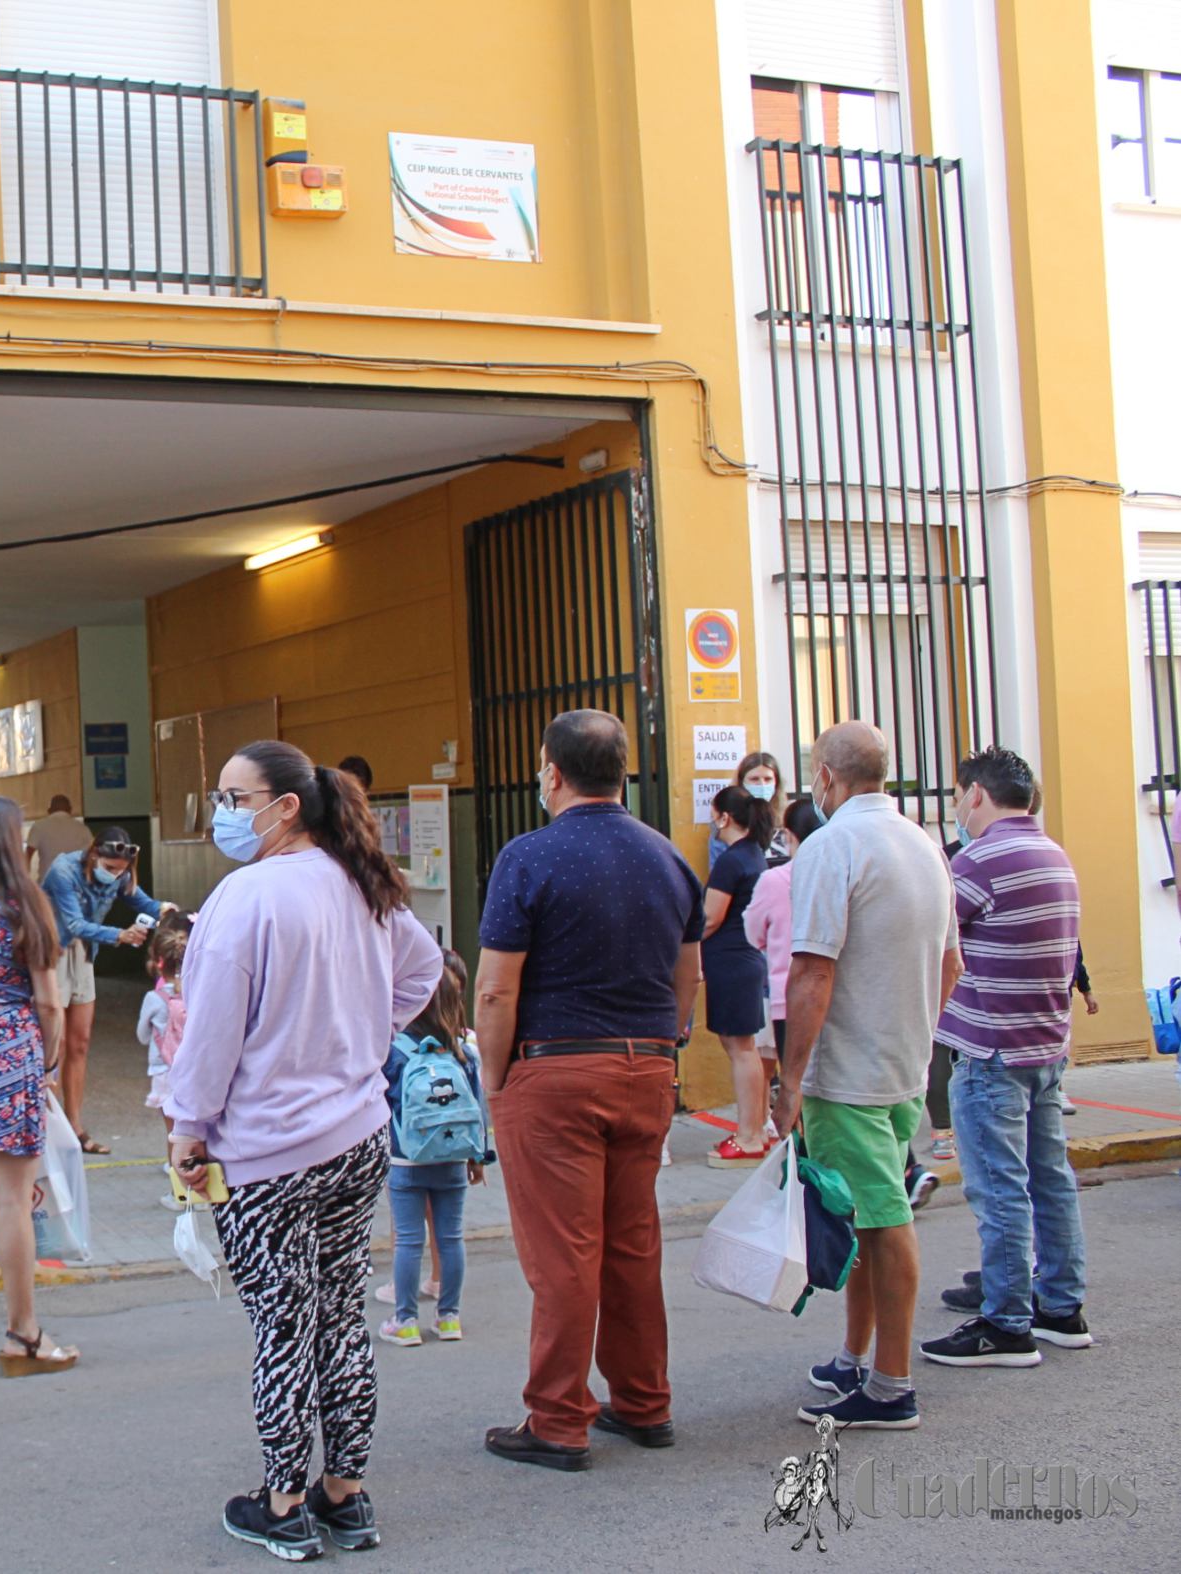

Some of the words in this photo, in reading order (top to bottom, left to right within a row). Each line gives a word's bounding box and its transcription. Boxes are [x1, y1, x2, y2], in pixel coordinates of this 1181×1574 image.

[407, 163, 426, 173] CEIP
[428, 165, 460, 176] MIGUEL
[462, 168, 473, 177] DE
[475, 169, 524, 181] CERVANTES
[433, 183, 449, 191] Part
[459, 185, 499, 195] Cambridge
[425, 190, 456, 199] National
[458, 192, 482, 201] School
[483, 194, 509, 204] Project
[698, 731, 735, 742] SALIDA
[696, 752, 702, 761] 4
[704, 750, 729, 761] AÑOS
[731, 752, 737, 761] B
